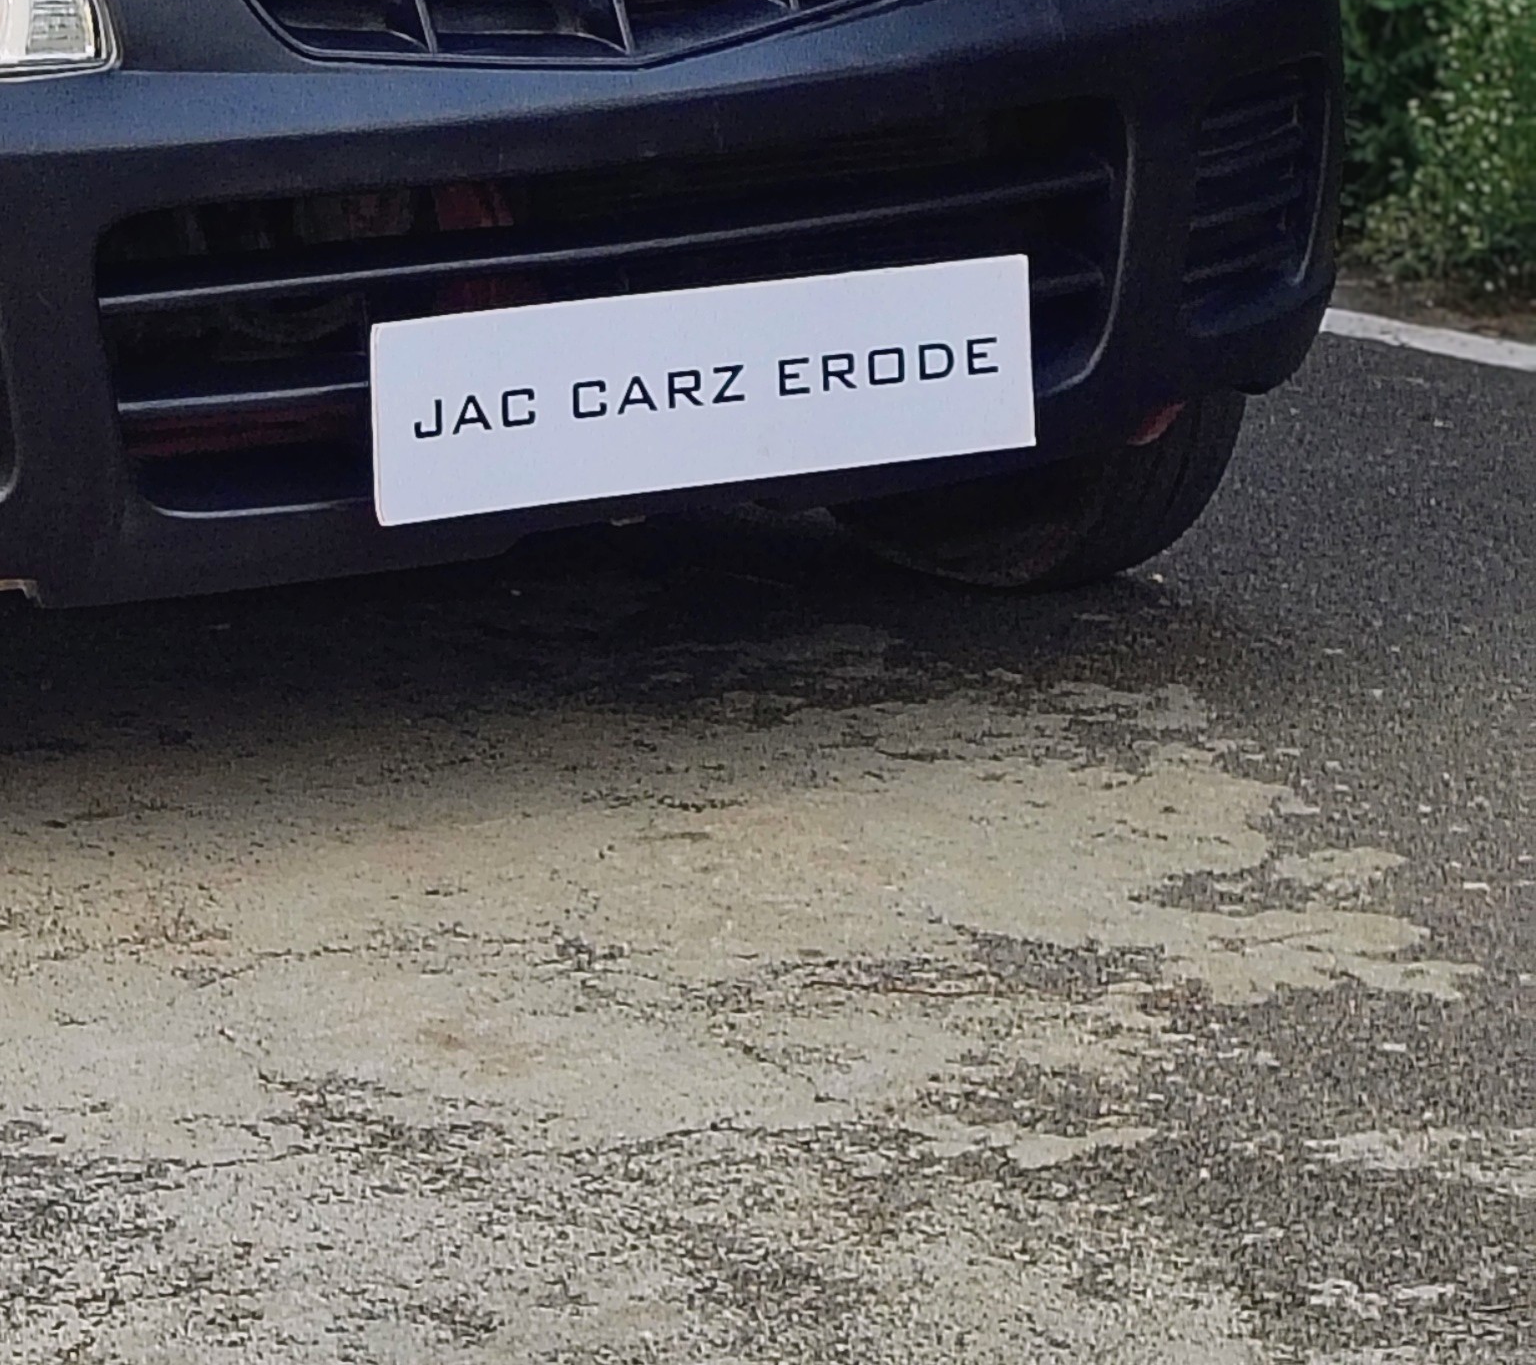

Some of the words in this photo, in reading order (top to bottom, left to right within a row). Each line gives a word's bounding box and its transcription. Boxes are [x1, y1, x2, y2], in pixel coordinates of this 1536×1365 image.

[413, 387, 537, 440] JAC
[571, 363, 746, 420] CARZ
[777, 336, 1000, 398] ERODE
